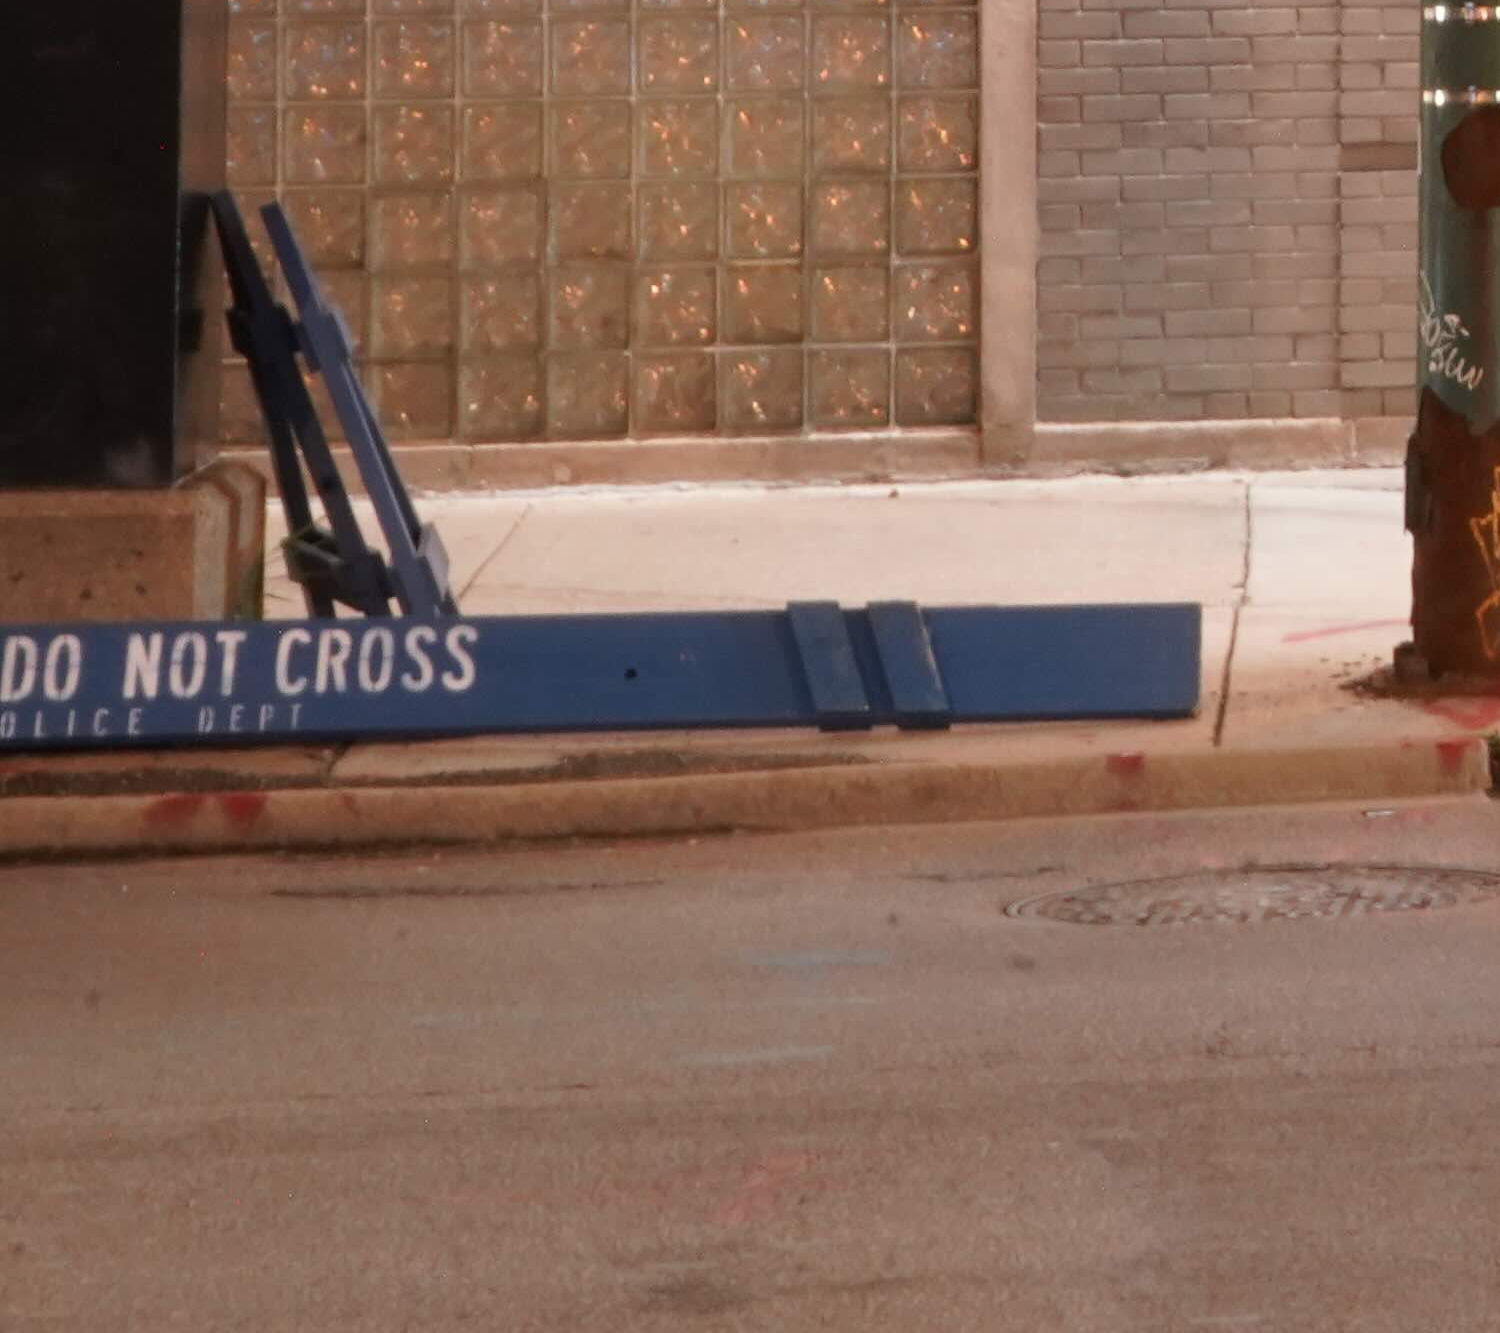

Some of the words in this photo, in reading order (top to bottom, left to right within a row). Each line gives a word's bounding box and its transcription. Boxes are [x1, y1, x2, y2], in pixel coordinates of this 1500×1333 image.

[0, 633, 83, 703] DO
[122, 630, 248, 701] NOT
[274, 625, 479, 697] CROSS
[0, 707, 145, 739] OLICE
